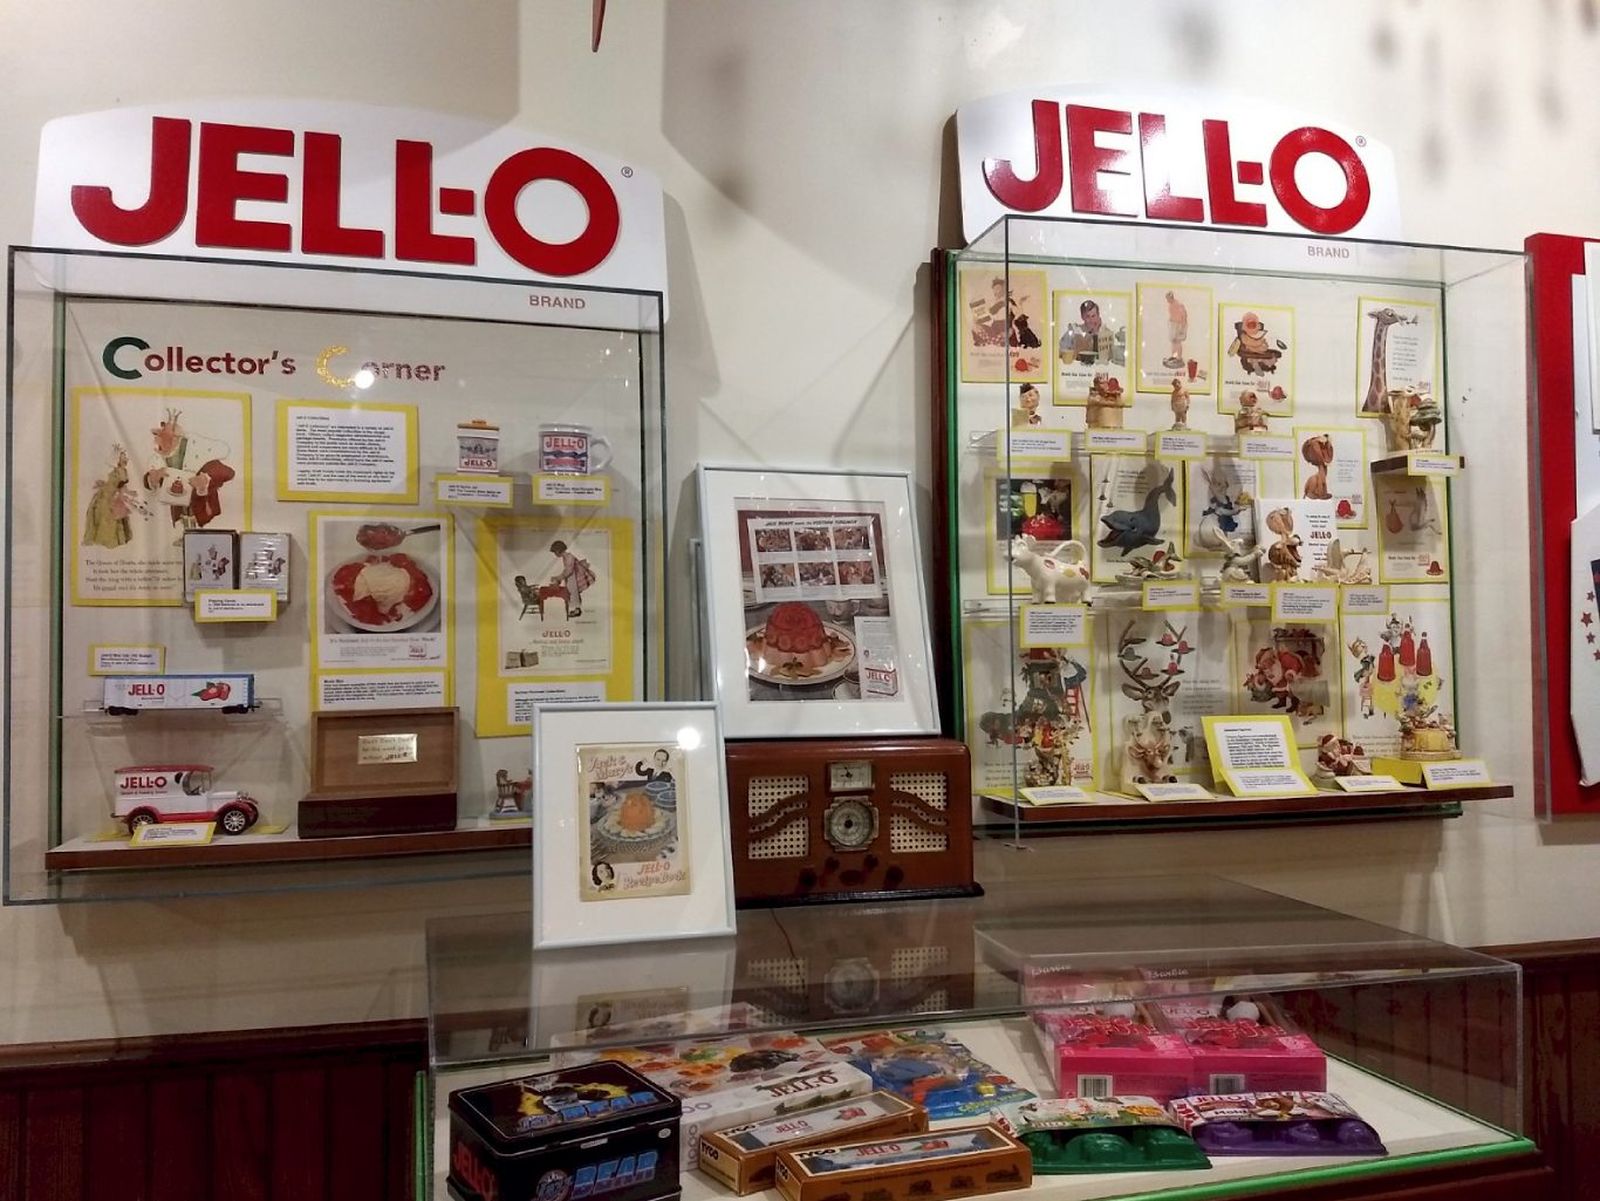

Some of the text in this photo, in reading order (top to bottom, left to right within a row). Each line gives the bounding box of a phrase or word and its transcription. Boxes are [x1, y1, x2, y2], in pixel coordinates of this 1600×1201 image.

[982, 99, 1371, 234] JELL-O
[71, 116, 620, 276] JELL-O
[1307, 245, 1350, 259] BRAND
[529, 294, 586, 309] BRAND
[103, 336, 296, 380] Collector's
[545, 437, 585, 449] JELL-O
[120, 776, 167, 789] JELL-O
[771, 1074, 839, 1099] JELL-O
[701, 1140, 719, 1161] TYCO
[794, 1148, 827, 1158] TYCO
